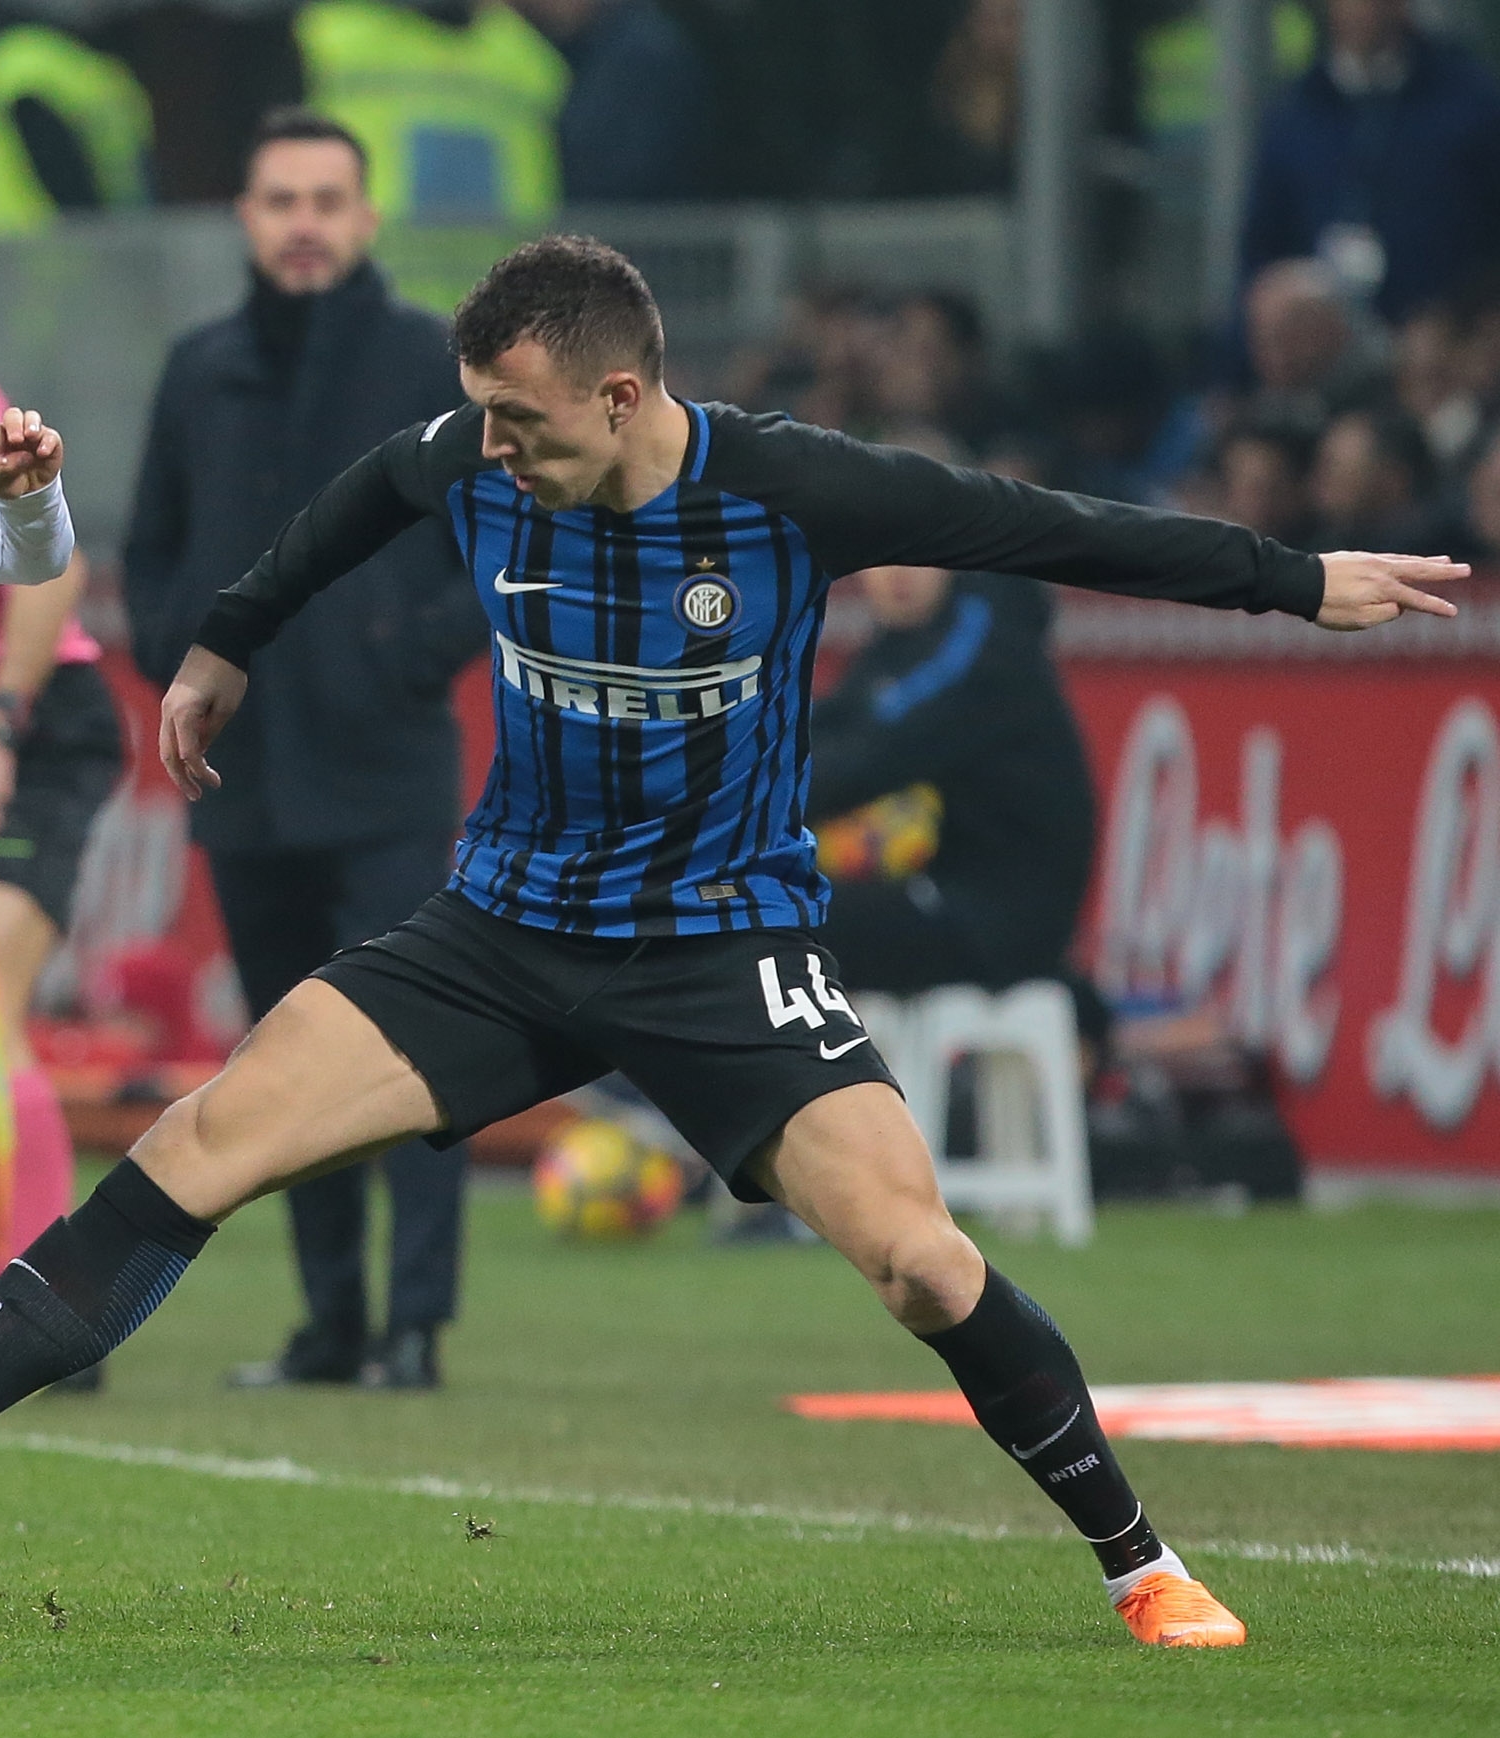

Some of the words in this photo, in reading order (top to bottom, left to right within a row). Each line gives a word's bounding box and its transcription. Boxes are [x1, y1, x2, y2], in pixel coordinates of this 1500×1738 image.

[496, 630, 763, 721] PIRELLI
[758, 953, 862, 1029] 44
[1047, 1453, 1101, 1483] INTER
